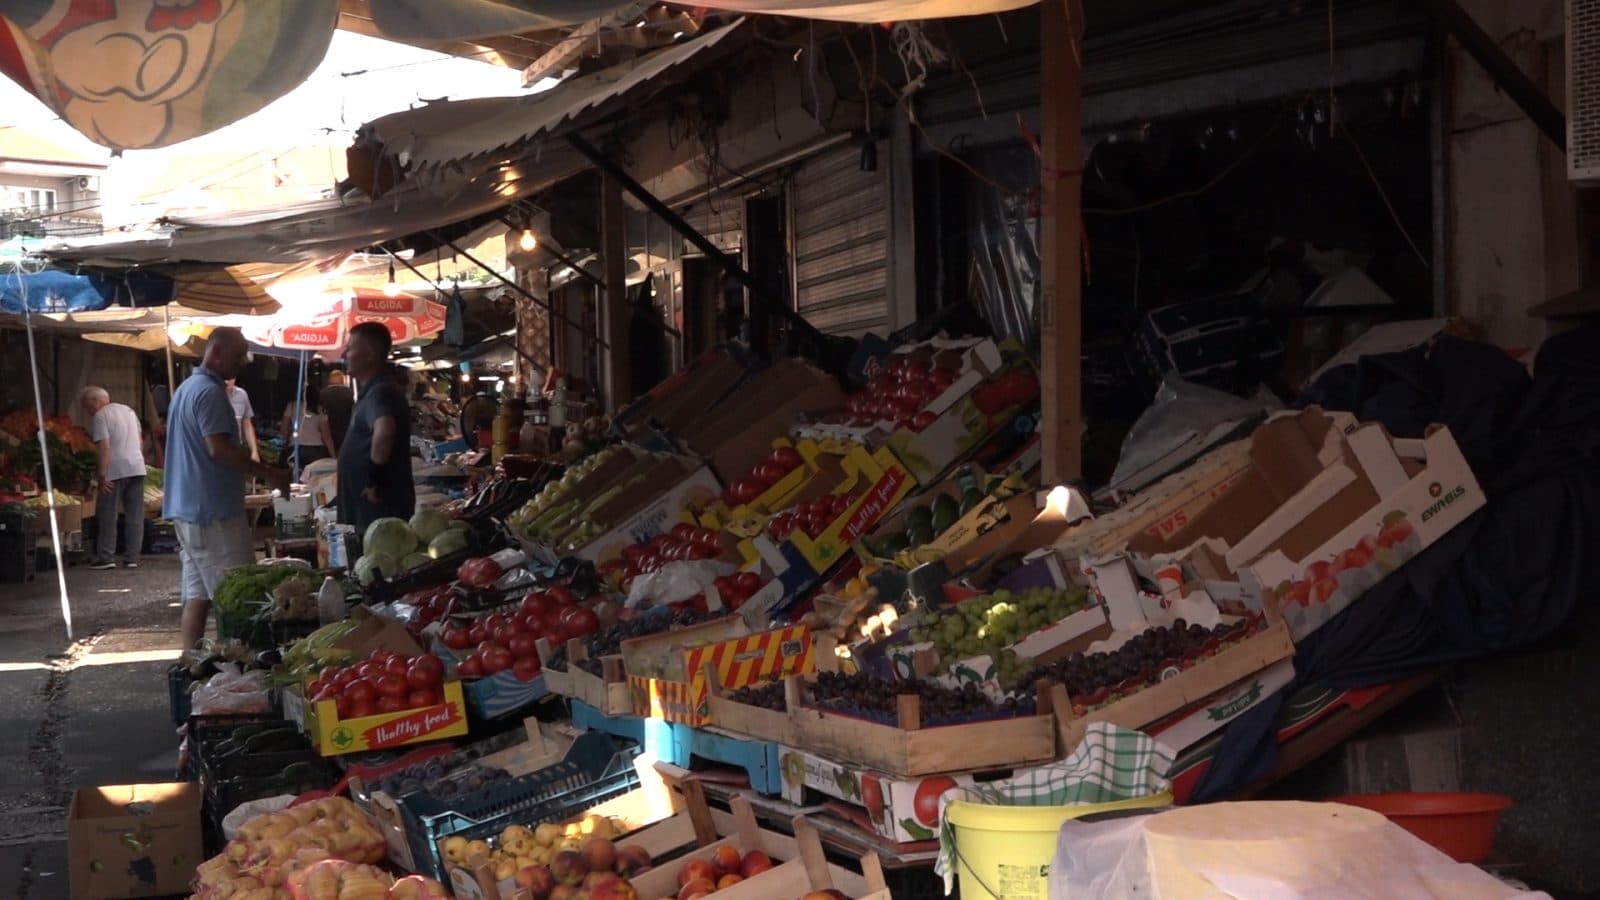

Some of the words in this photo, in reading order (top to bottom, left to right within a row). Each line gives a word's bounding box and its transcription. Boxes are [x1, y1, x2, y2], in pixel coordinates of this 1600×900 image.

[367, 301, 403, 310] ALGIDA
[376, 720, 421, 745] Healthy
[424, 708, 450, 730] food
